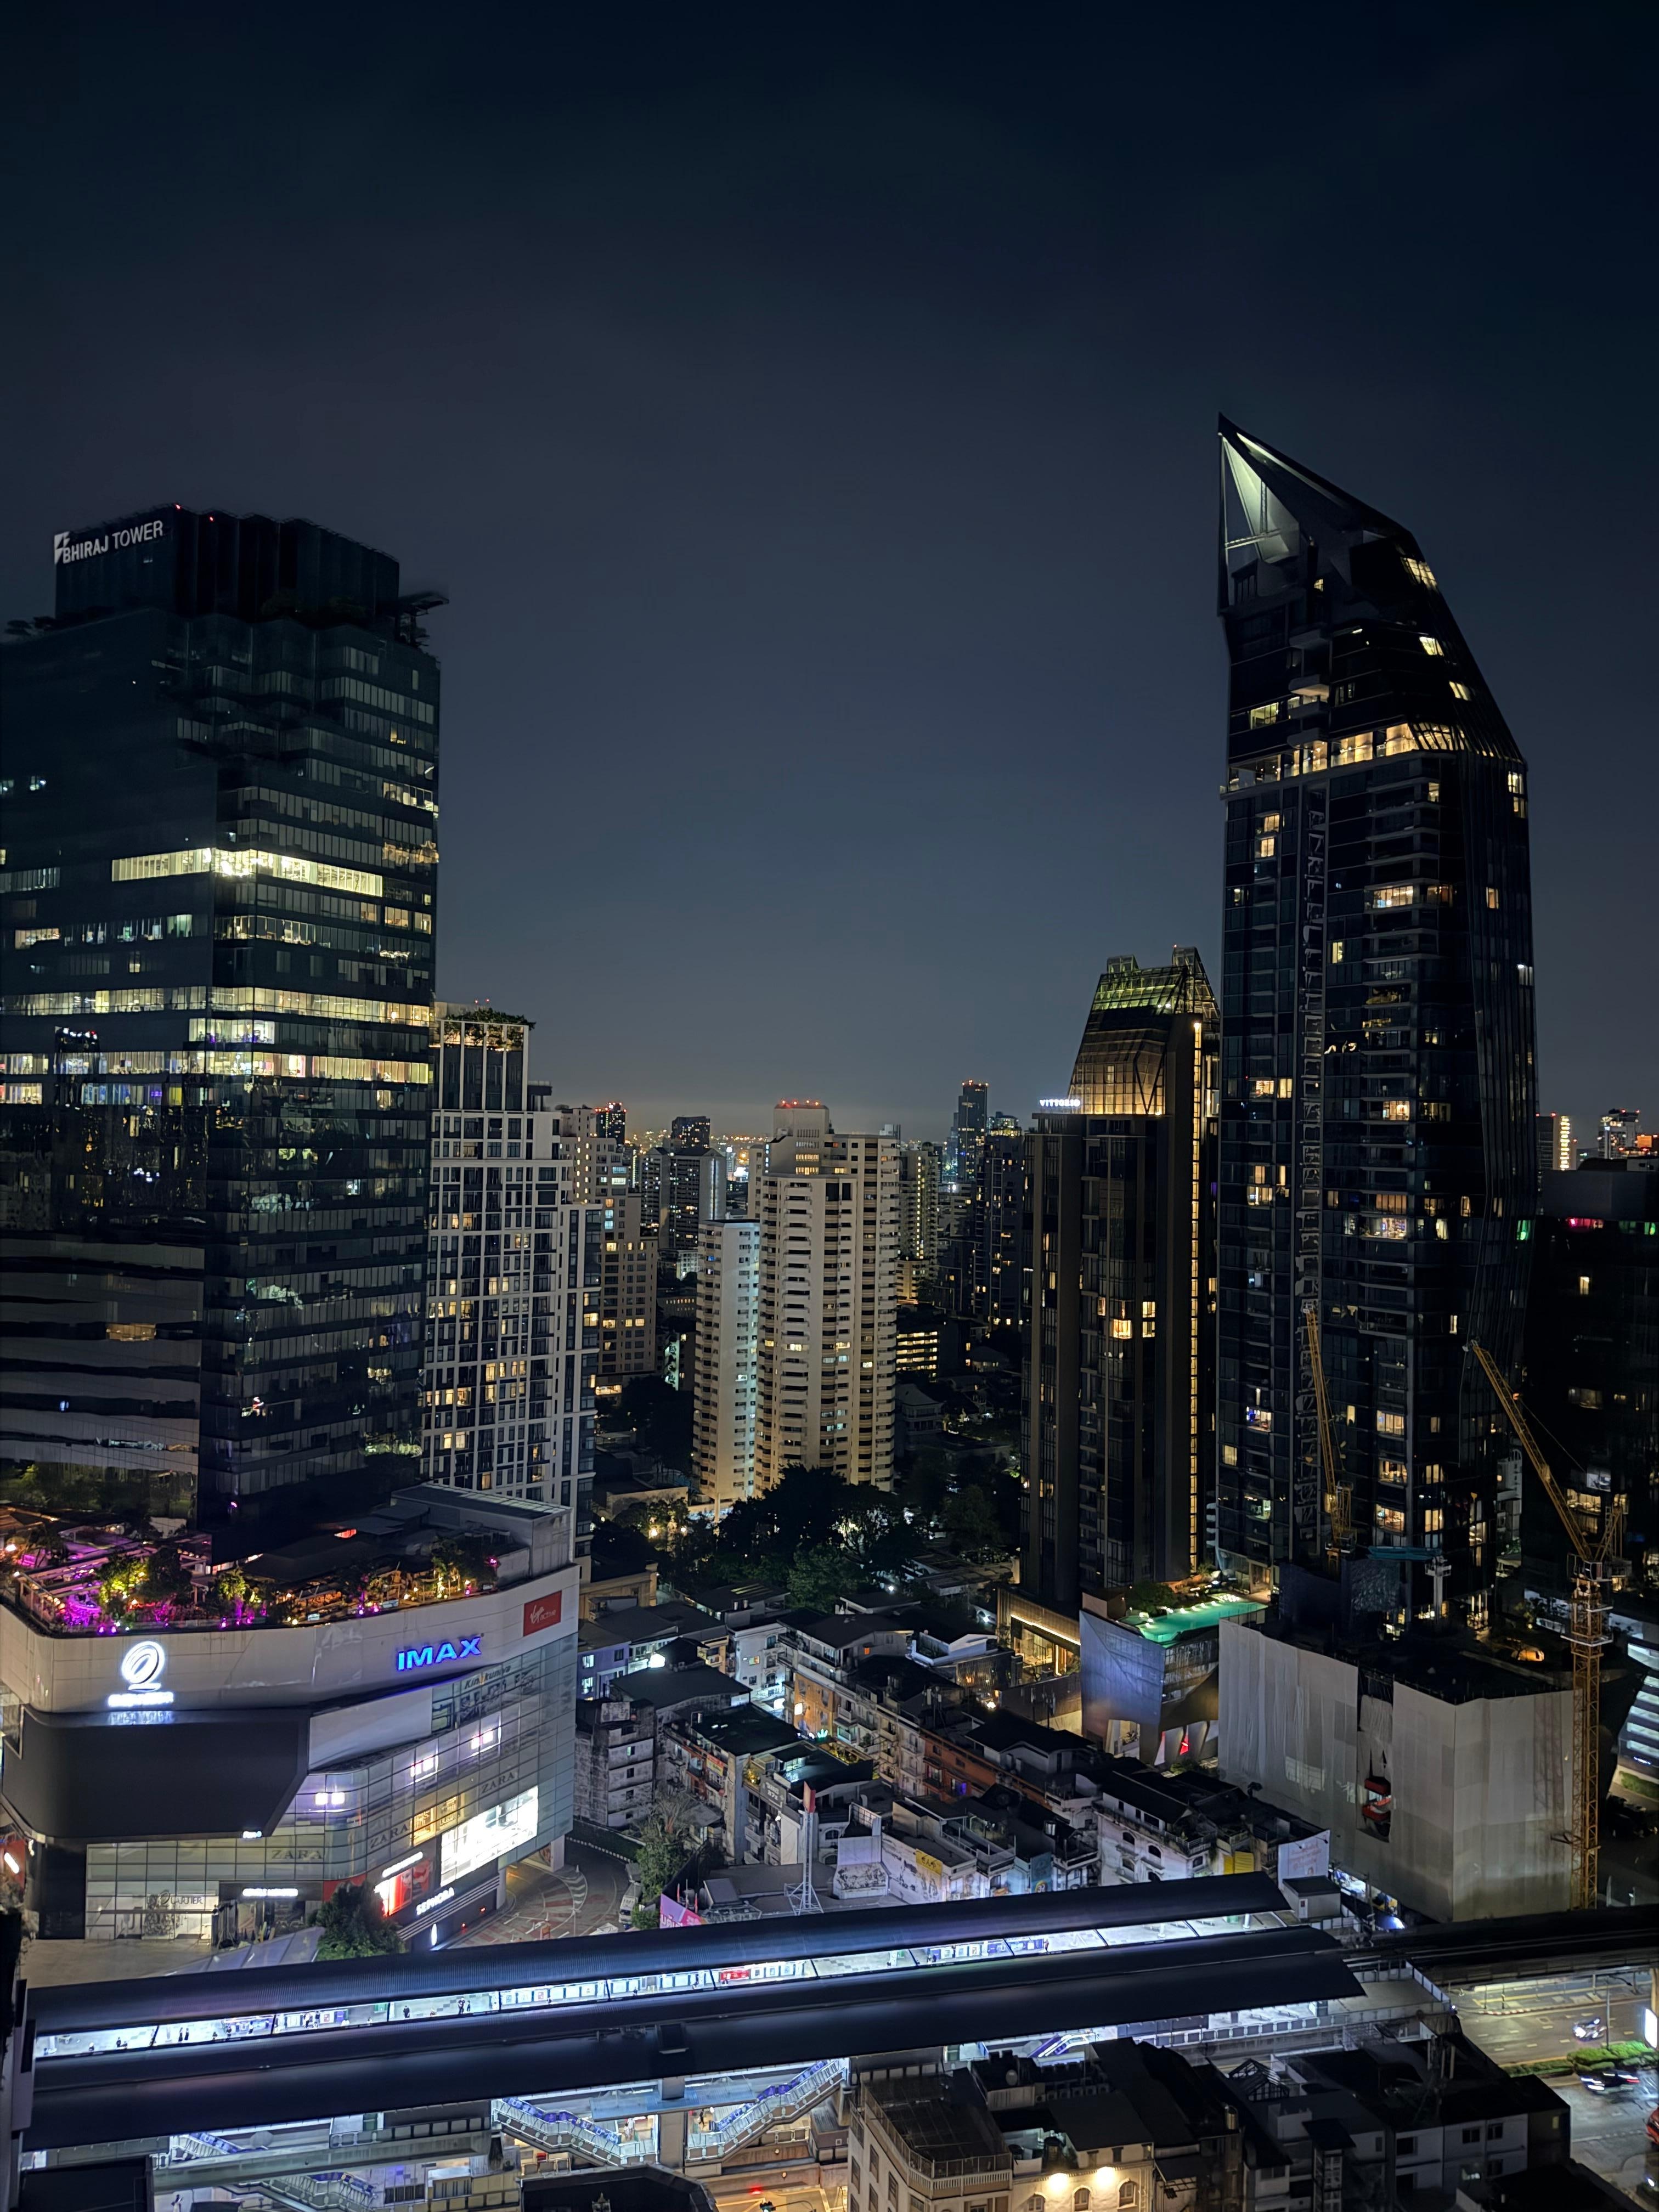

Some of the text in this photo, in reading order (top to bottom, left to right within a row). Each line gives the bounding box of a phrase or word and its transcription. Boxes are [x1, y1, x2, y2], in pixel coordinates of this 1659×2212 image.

[63, 520, 163, 564] BHIRAJ TOWER
[398, 1637, 482, 1671] IMAX
[482, 1772, 514, 1793] ZARA
[370, 1824, 408, 1849] ZARA
[272, 1849, 323, 1859] ZARA
